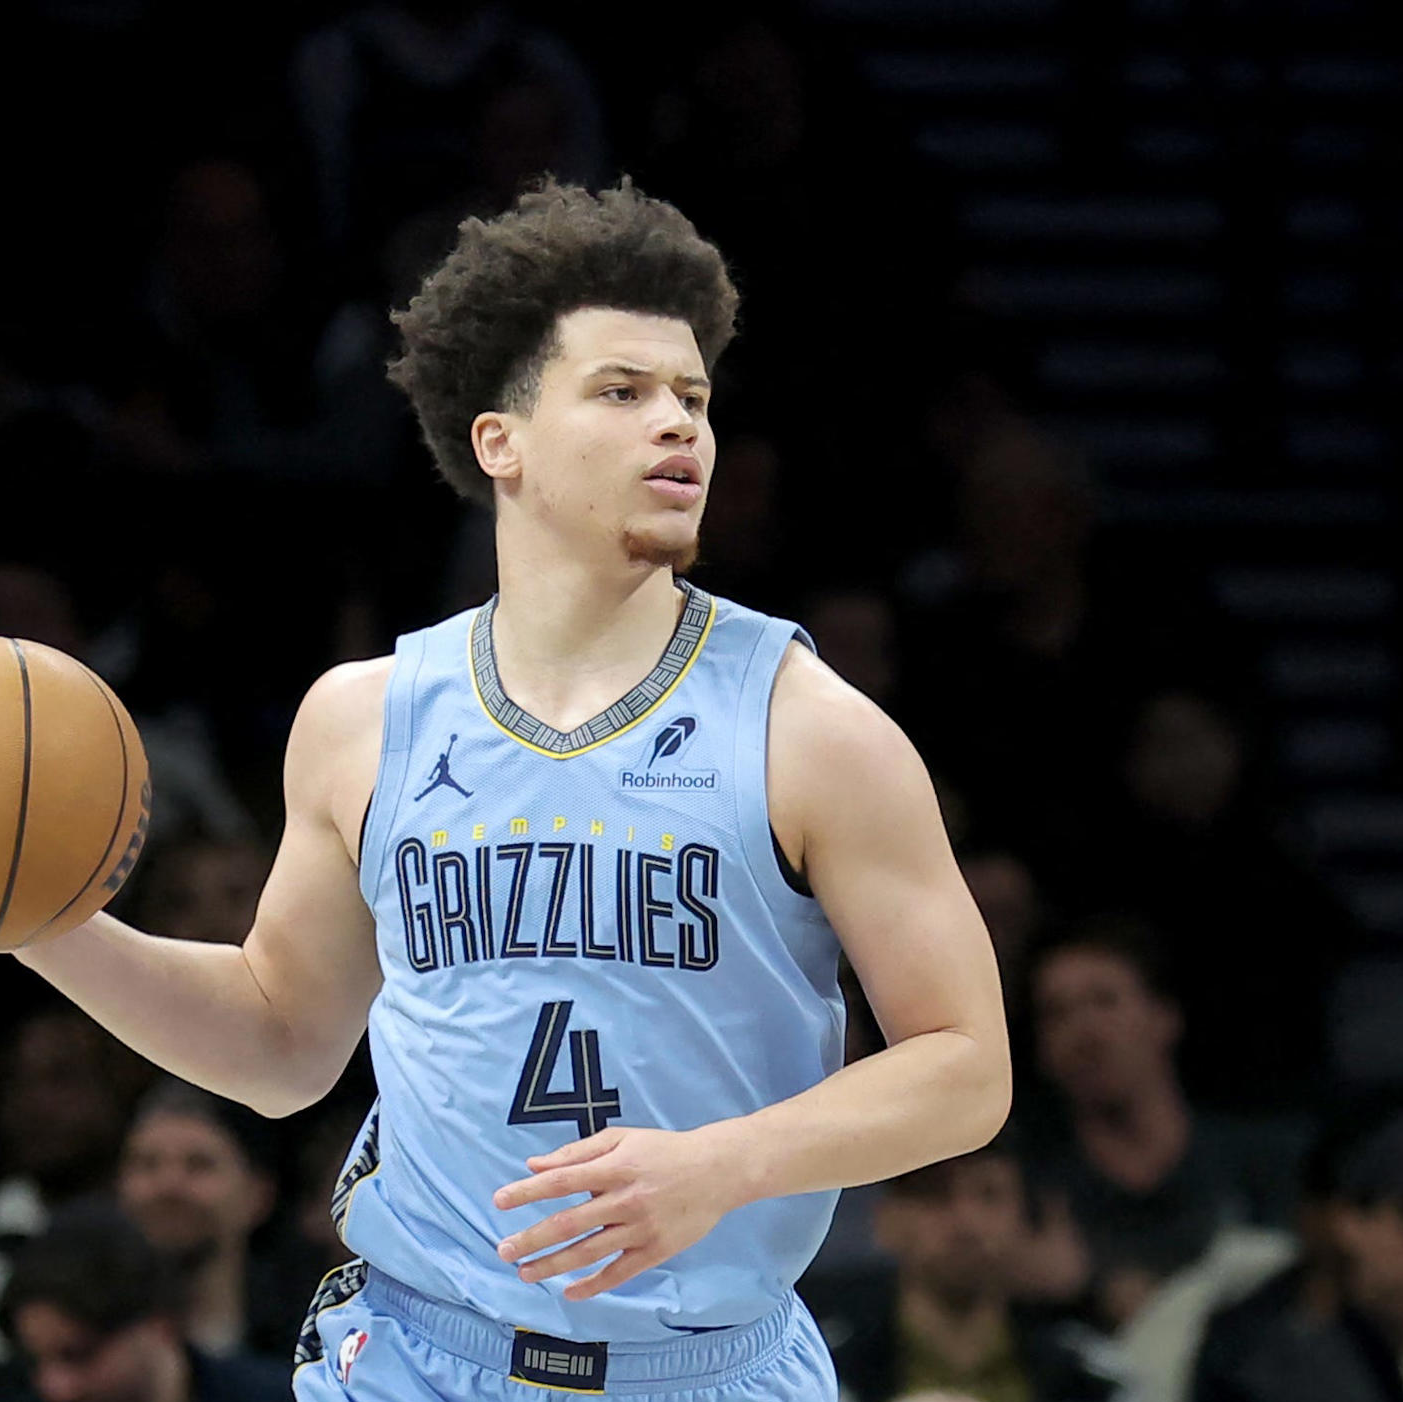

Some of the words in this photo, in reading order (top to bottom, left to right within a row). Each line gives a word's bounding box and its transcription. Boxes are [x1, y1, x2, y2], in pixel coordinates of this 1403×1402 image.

[621, 772, 716, 790] Robinhood
[431, 817, 674, 851] MEMPHIS
[397, 837, 719, 974] GRIZZLIES
[507, 1000, 622, 1139] 4
